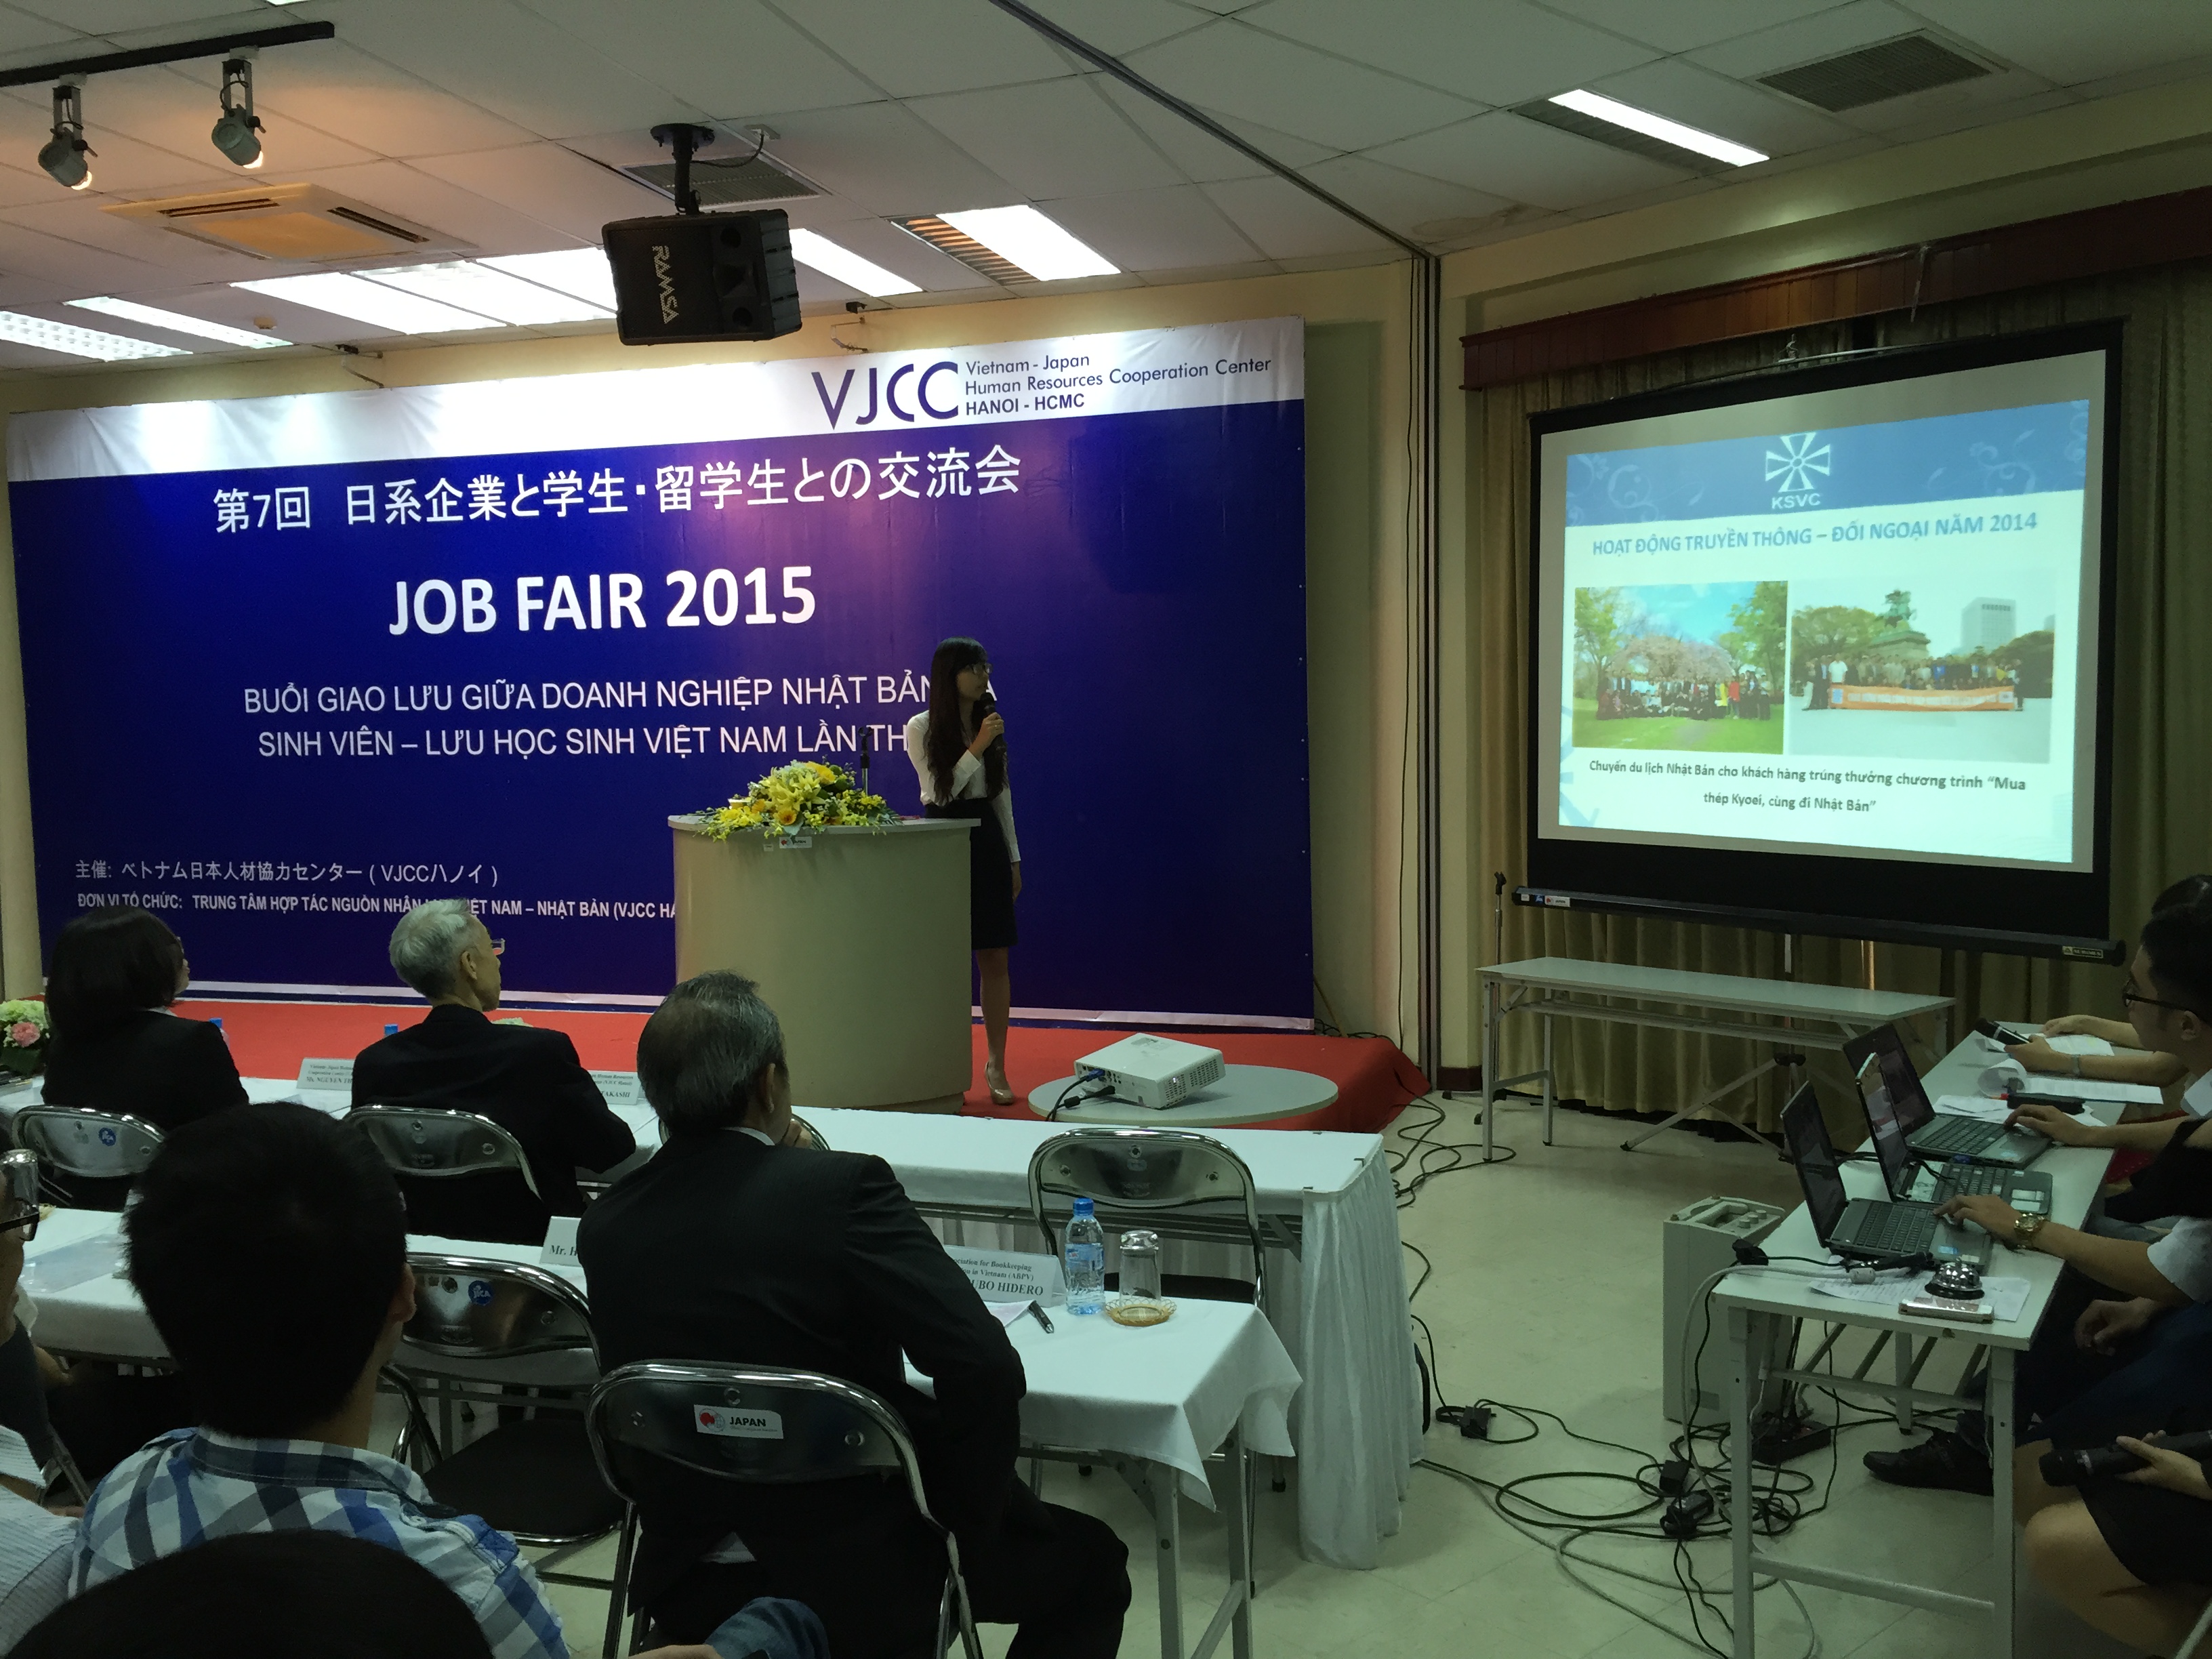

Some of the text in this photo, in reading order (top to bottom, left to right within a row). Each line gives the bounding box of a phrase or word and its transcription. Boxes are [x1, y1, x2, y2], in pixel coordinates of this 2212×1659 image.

[652, 245, 678, 324] RAMSA
[965, 359, 1271, 396] Human Resources Cooperation Center
[966, 361, 1029, 377] Vietnam
[1043, 354, 1090, 373] Japan
[811, 361, 958, 430] VJCC
[966, 398, 1018, 416] HANOI
[1034, 393, 1085, 411] HCMC
[213, 444, 1021, 533] 第7回 日系企業と学生・留学生との交流会
[1771, 493, 1821, 510] KSVC
[1593, 539, 1632, 557] HOẠT
[1635, 533, 1681, 556] ĐỘNG
[1685, 527, 1748, 551] TRUYỀN
[1753, 527, 1811, 547] THÔNG
[1832, 519, 1864, 542] ĐỐI
[1870, 520, 1929, 541] NGOẠI
[1935, 513, 1983, 536] NĂM
[1990, 512, 2037, 532] 2014
[390, 565, 816, 636] JOB FAIR 2015
[244, 682, 309, 714] BUỔI
[318, 685, 385, 712] GIAO
[394, 684, 452, 711] LƯU
[462, 679, 535, 710] GIỮA
[543, 681, 646, 710] DOANH
[657, 676, 773, 711] NGHIỆP
[783, 674, 867, 710] NHẬT
[258, 731, 321, 757] SINH
[329, 724, 393, 756] VIÊN
[426, 729, 484, 756] LƯU
[495, 727, 556, 760] HỌC
[565, 726, 634, 754] SINH
[644, 724, 711, 758] VIỆT
[721, 724, 786, 753] NAM
[797, 719, 857, 753] LẦN
[866, 724, 907, 752] TH
[1589, 760, 1626, 775] Chuyến
[1629, 762, 1643, 773] du
[1645, 762, 1663, 775] lịch
[1667, 763, 1692, 777] Nhật
[1695, 764, 1715, 777] Bản
[1718, 765, 1738, 777] cho
[1742, 766, 1774, 779] khách
[1777, 767, 1806, 782] hàng
[1809, 769, 1841, 784] trúng
[1845, 771, 1893, 786] thưởng
[1896, 773, 1946, 790] chương
[1950, 775, 1983, 788] trình
[1704, 792, 1729, 806] thép
[1732, 793, 1765, 807] Kyoei,
[1769, 795, 1795, 810] cùng
[1799, 797, 1810, 808] đi
[1814, 798, 1843, 813] Nhật
[77, 893, 104, 907] ĐƠN
[142, 891, 182, 909] CHỨC:
[192, 894, 237, 910] TRUNG
[239, 892, 267, 911] TÂM
[270, 895, 298, 914] HỢP
[301, 894, 329, 912] TÁC
[331, 895, 380, 912] NGUỒN
[491, 900, 522, 915] NAM
[537, 899, 575, 920] NHẬT
[580, 898, 609, 917] BẢN
[613, 901, 655, 921] (VJCC
[550, 1245, 567, 1255] Mr.
[979, 1259, 989, 1267] for
[991, 1261, 1032, 1273] Bookkeeping
[980, 1269, 1007, 1279] Vietnam
[970, 1279, 1044, 1296] UBO HIDERO
[730, 1416, 766, 1427] JAPAN
